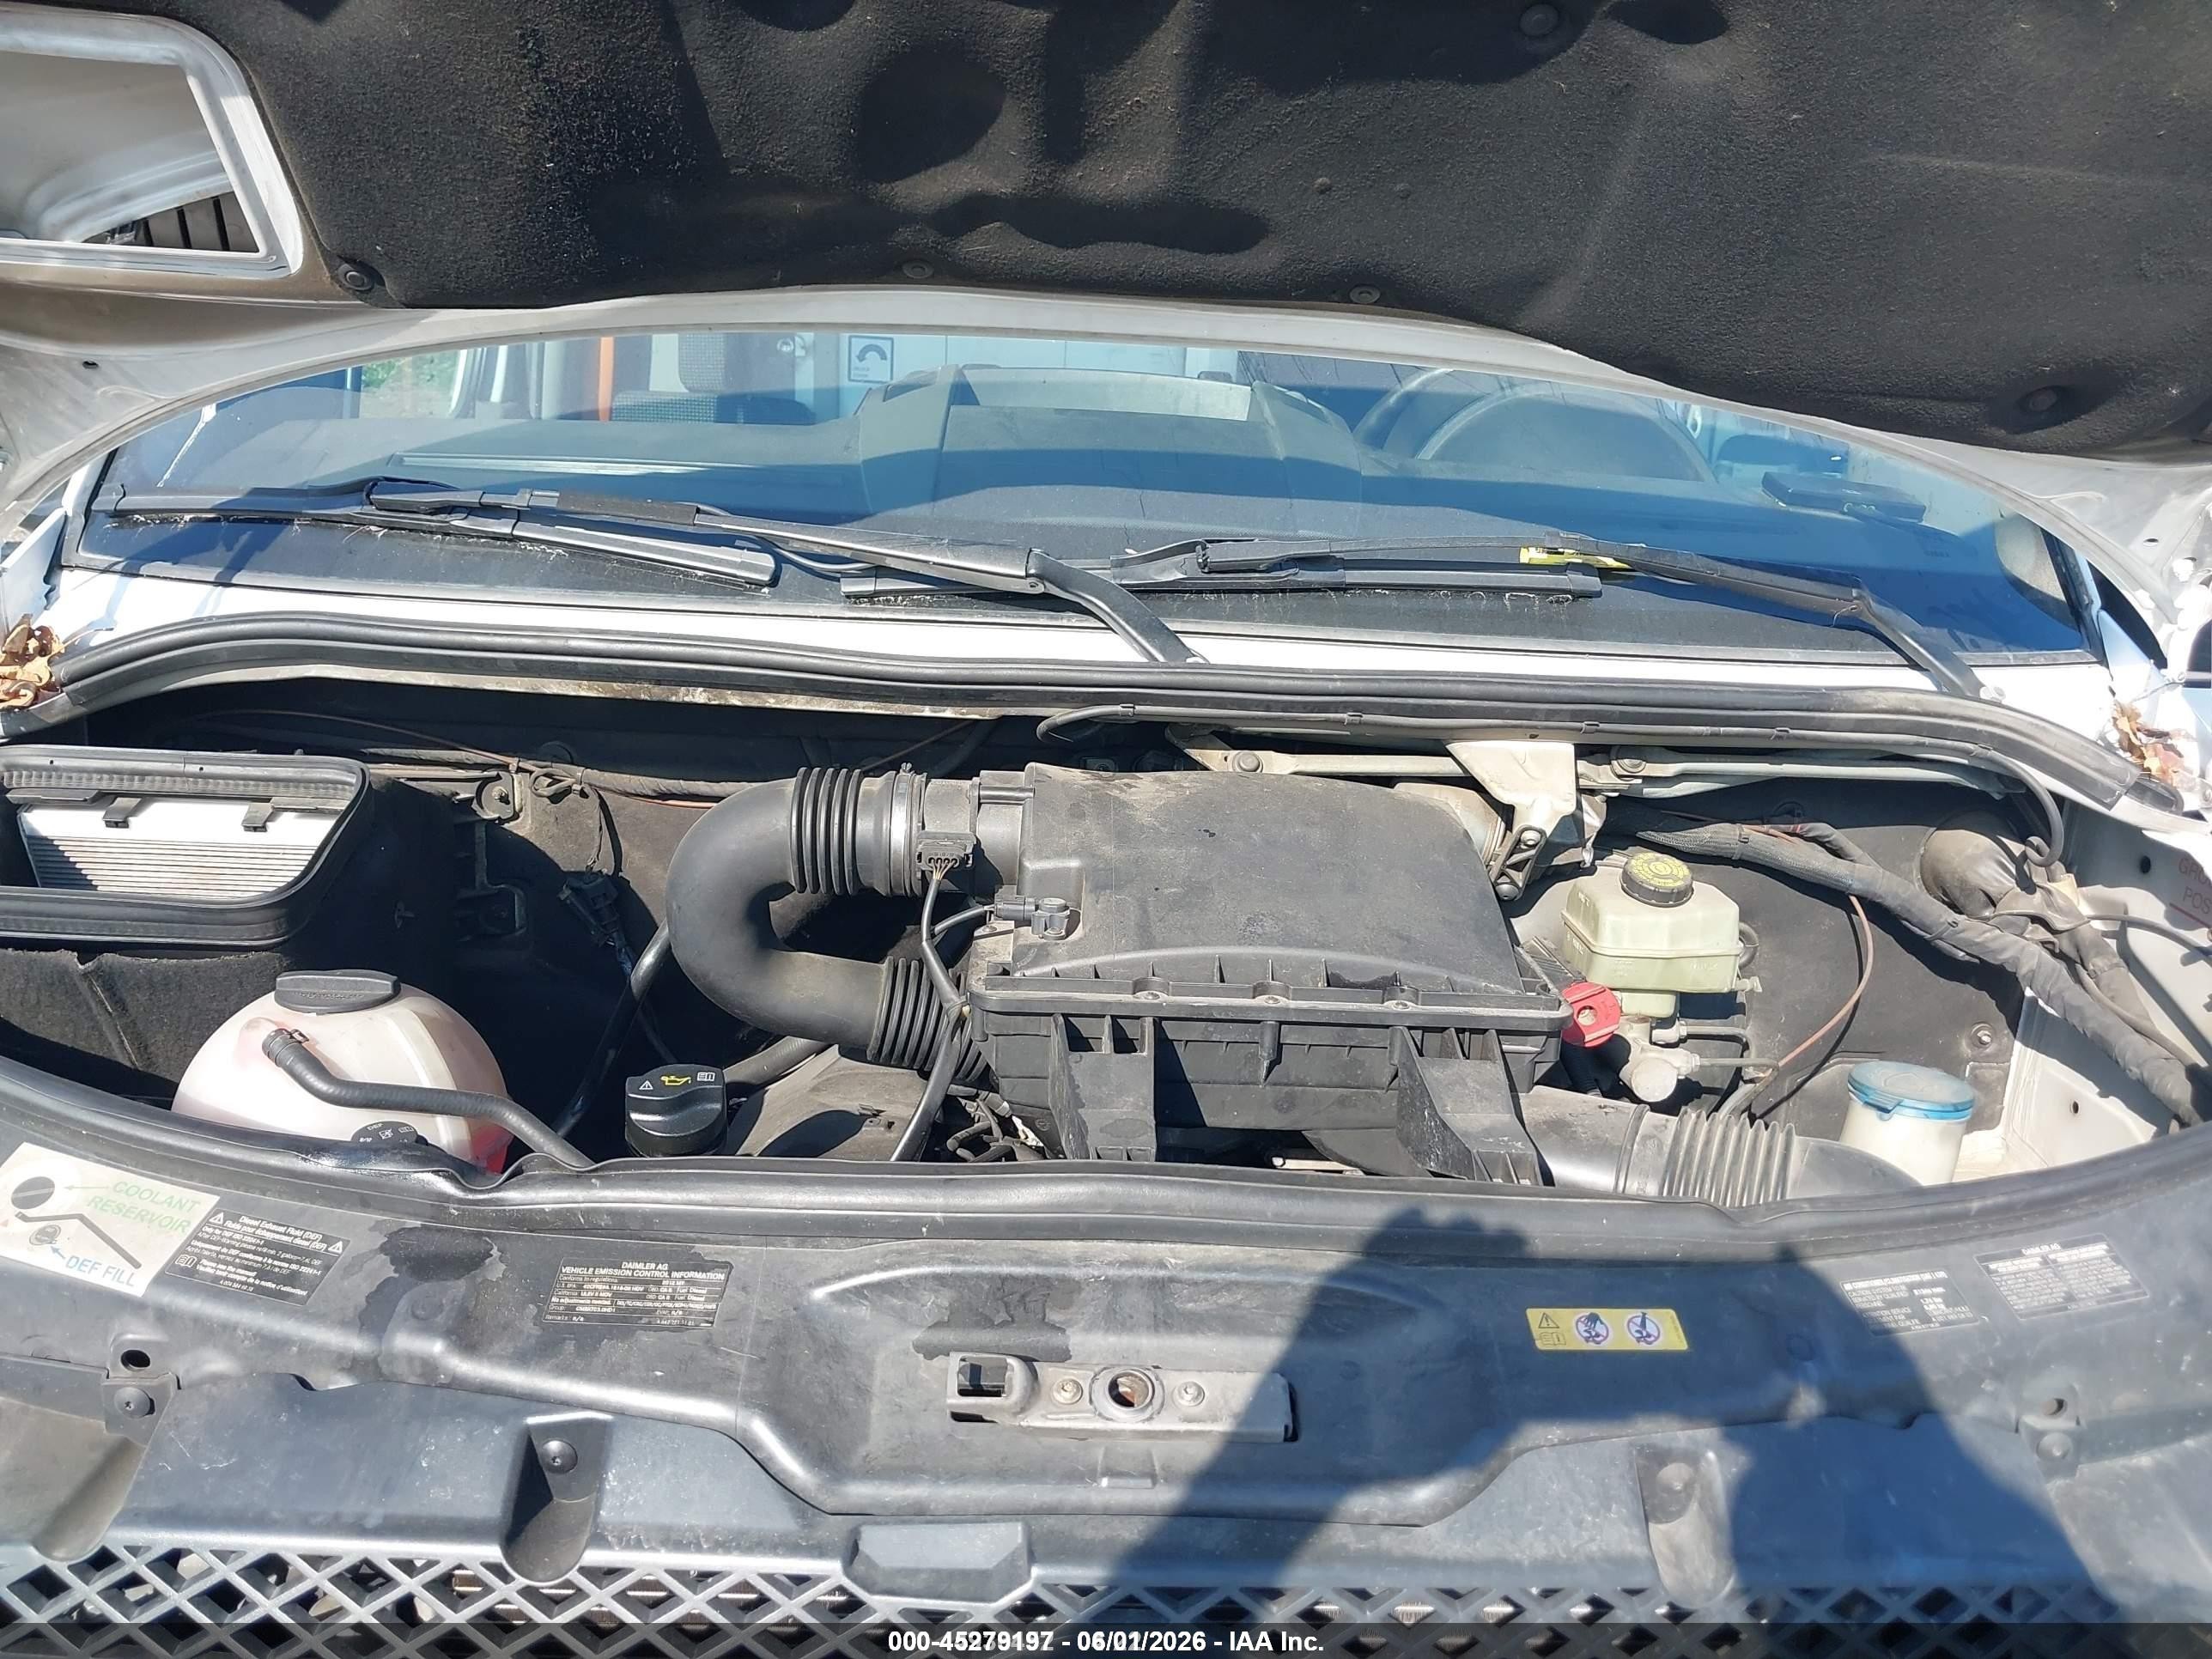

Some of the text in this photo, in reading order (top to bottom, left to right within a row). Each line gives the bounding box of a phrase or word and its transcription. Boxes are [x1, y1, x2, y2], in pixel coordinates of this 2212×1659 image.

[112, 1181, 200, 1212] COOLANT
[87, 1194, 191, 1235] RESERVOIR
[239, 1216, 261, 1226] Diesel
[302, 1231, 323, 1243] (DEF)
[65, 1255, 136, 1287] DEF FILL
[672, 1271, 725, 1279] INFORMATION
